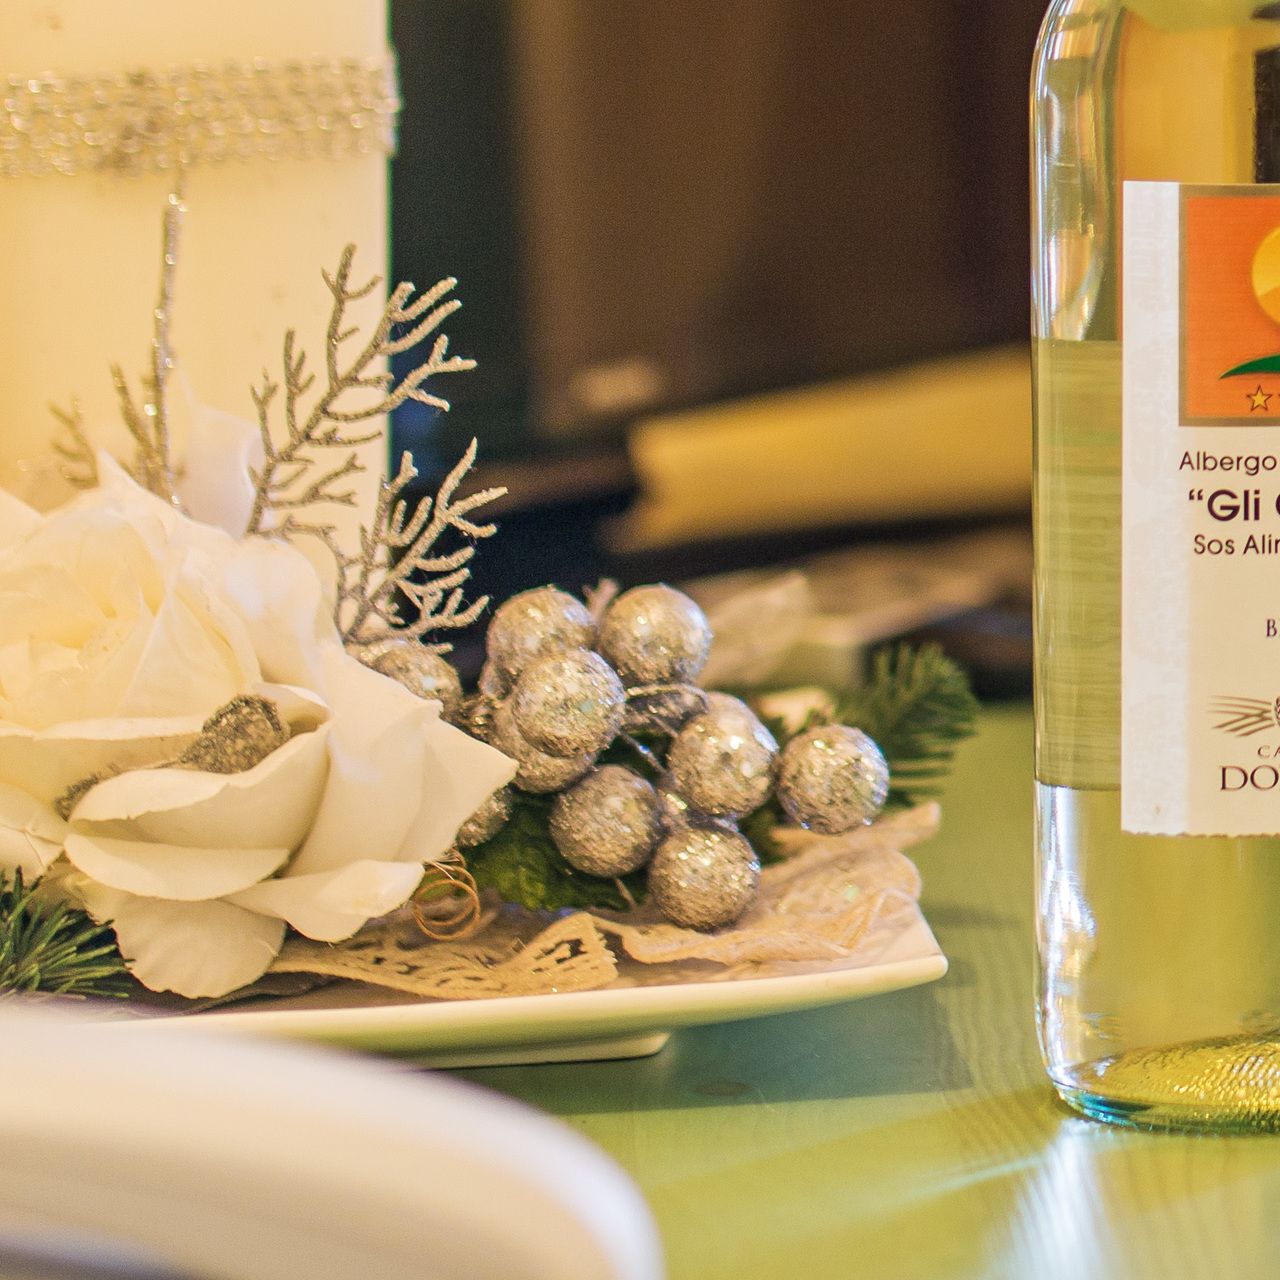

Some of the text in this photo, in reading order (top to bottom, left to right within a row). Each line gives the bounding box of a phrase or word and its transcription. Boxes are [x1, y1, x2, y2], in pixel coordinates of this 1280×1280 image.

[1179, 450, 1277, 476] Albergo
[1188, 488, 1261, 521] “Gli
[1194, 534, 1235, 555] Sos
